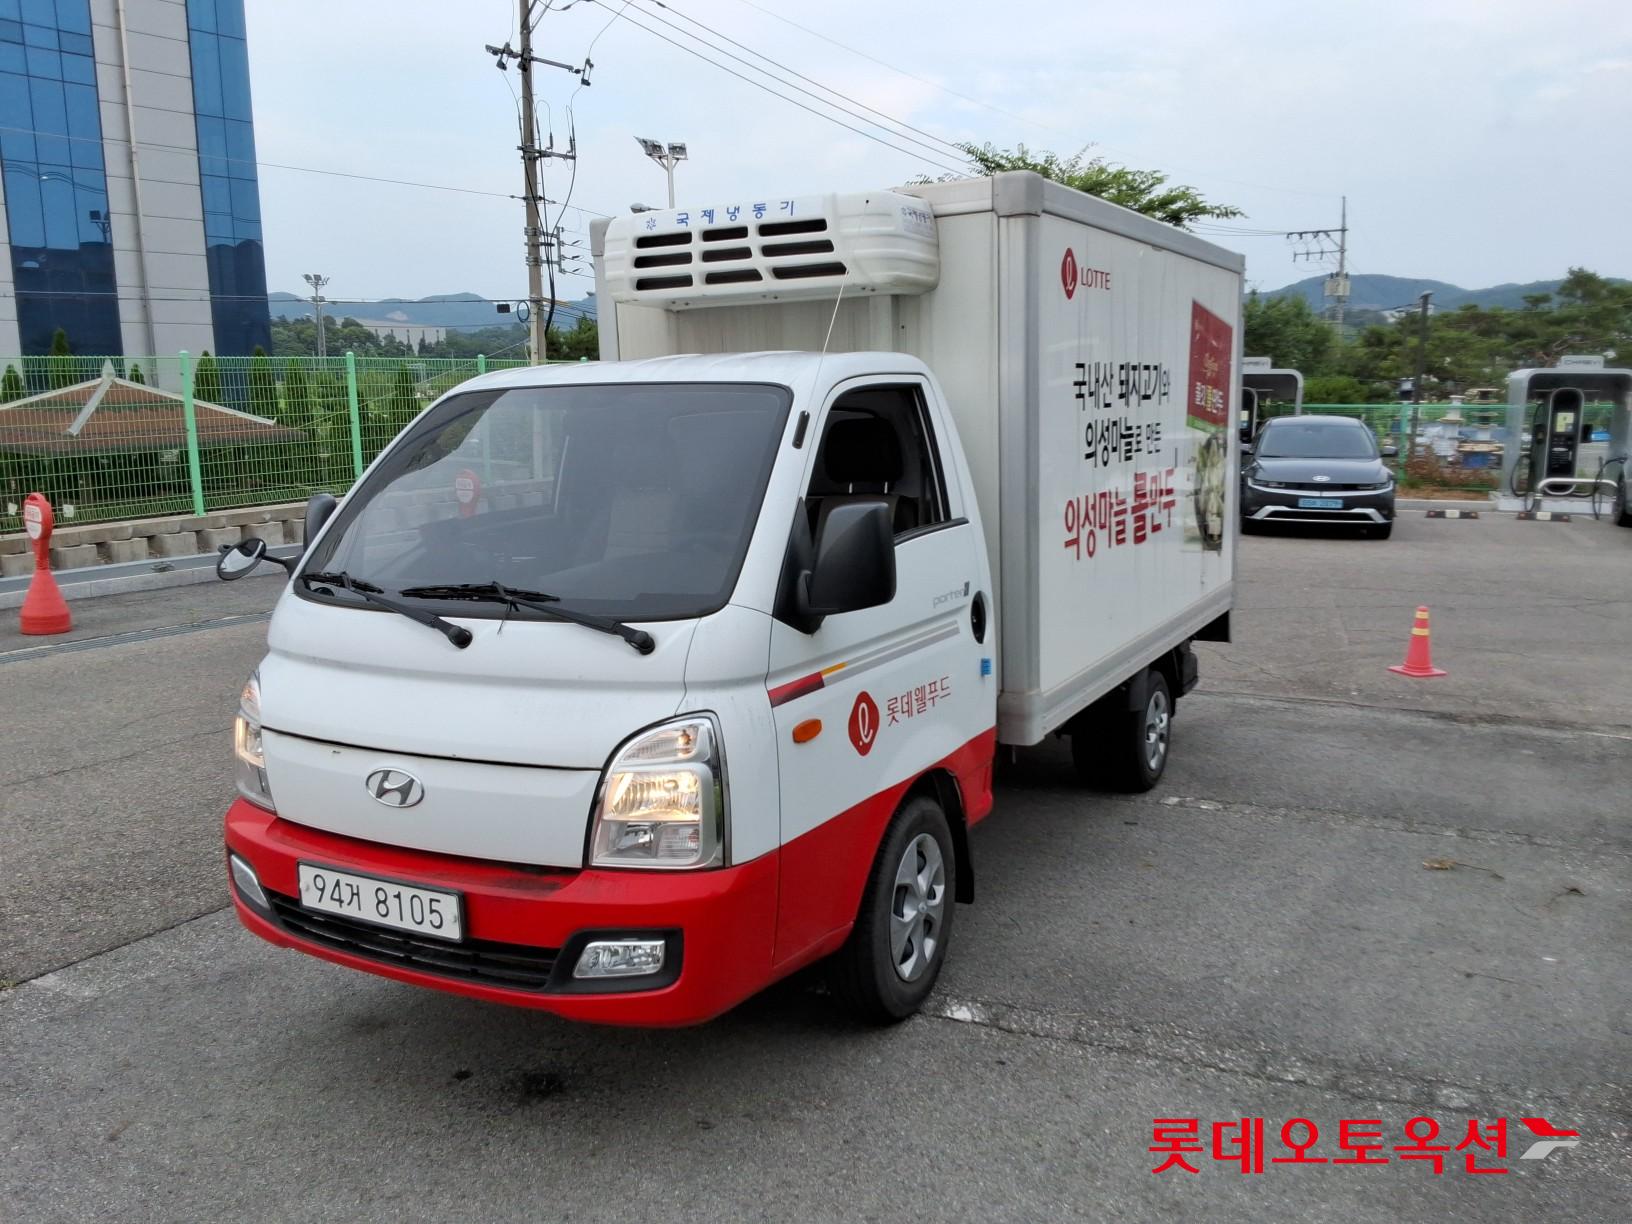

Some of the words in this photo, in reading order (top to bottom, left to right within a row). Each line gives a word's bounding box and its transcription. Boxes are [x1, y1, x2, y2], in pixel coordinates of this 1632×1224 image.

[676, 200, 795, 227] 국제냉동기
[1080, 267, 1111, 290] LOTTE
[1073, 362, 1114, 411] 국내산
[1118, 362, 1171, 408] 돼지고기와
[1085, 417, 1142, 468] 의성마늘로
[1064, 487, 1128, 560] 의성마늘
[887, 676, 951, 727] 롯데웰푸드
[313, 874, 361, 911] 94거
[375, 887, 443, 929] 8105
